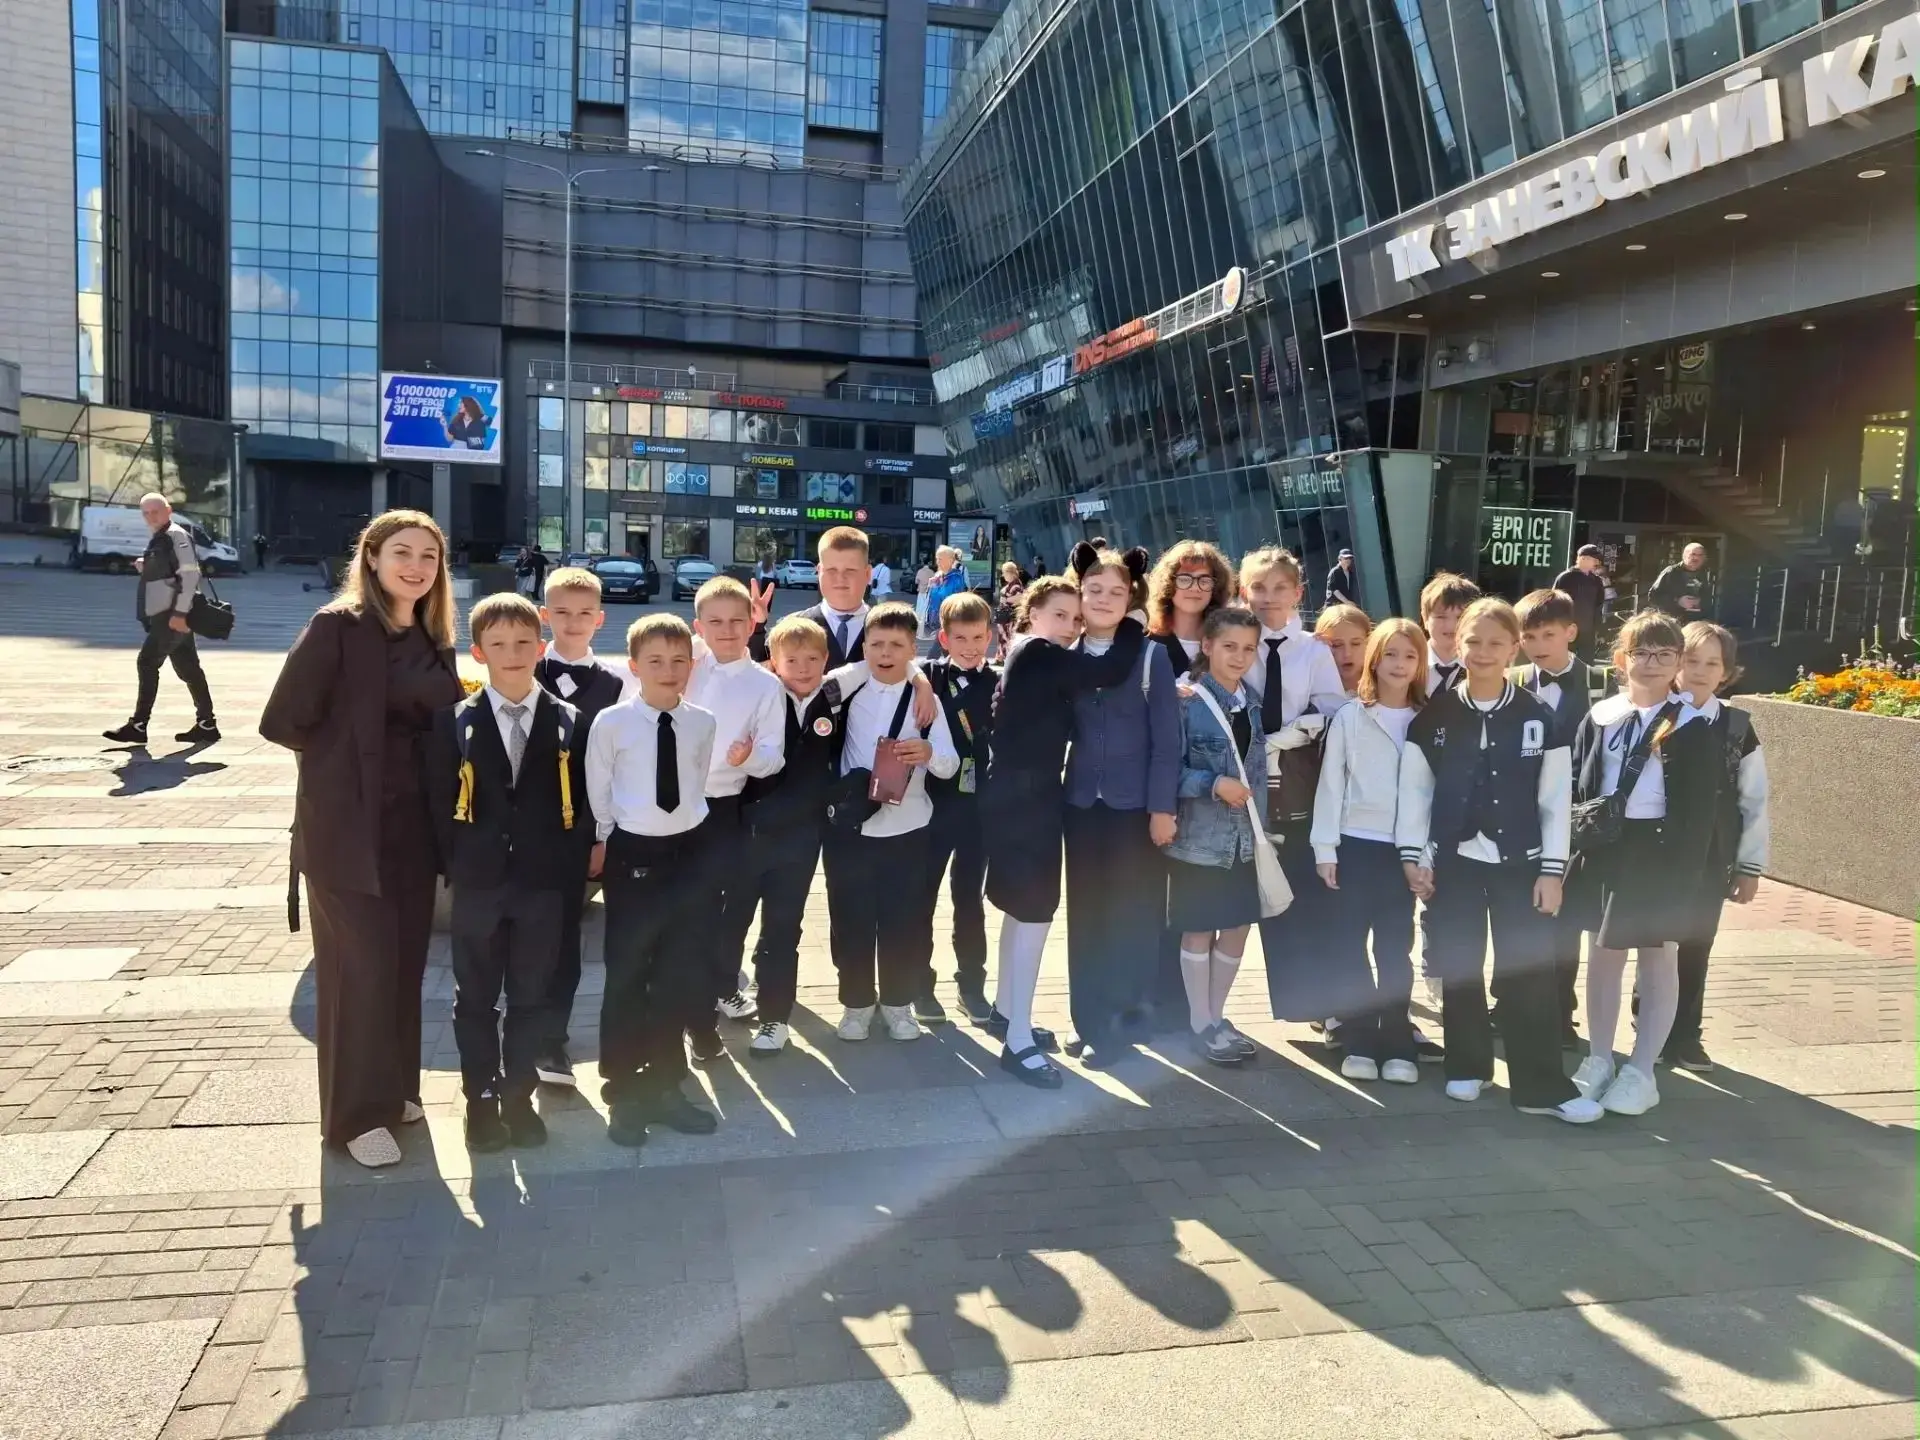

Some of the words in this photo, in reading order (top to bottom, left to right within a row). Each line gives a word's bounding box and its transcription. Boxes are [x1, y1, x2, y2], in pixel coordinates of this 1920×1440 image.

[1385, 223, 1441, 283] ТК
[1445, 66, 1784, 260] ЗАНЕВСКИЙ
[1802, 12, 1919, 128] КА
[1073, 334, 1107, 376] DNS
[476, 385, 493, 393] ВТБ
[394, 396, 405, 405] ЗА
[406, 397, 445, 408] ПЕРЕВОД
[392, 405, 410, 416] ЗП
[420, 406, 443, 418] ВТБ
[646, 446, 686, 454] КОПИЦЕНТР
[751, 455, 795, 466] ЛОМБАРД
[876, 458, 914, 467] СПОРТИВНОЕ
[666, 472, 707, 486] ФОТО
[736, 504, 758, 514] ШЕФ
[768, 507, 799, 516] КЕБАБ
[807, 508, 854, 520] ЦВЕТЫ
[1491, 515, 1503, 539] ONE
[1502, 515, 1553, 541] PRICE
[1491, 541, 1552, 567] COFFEE
